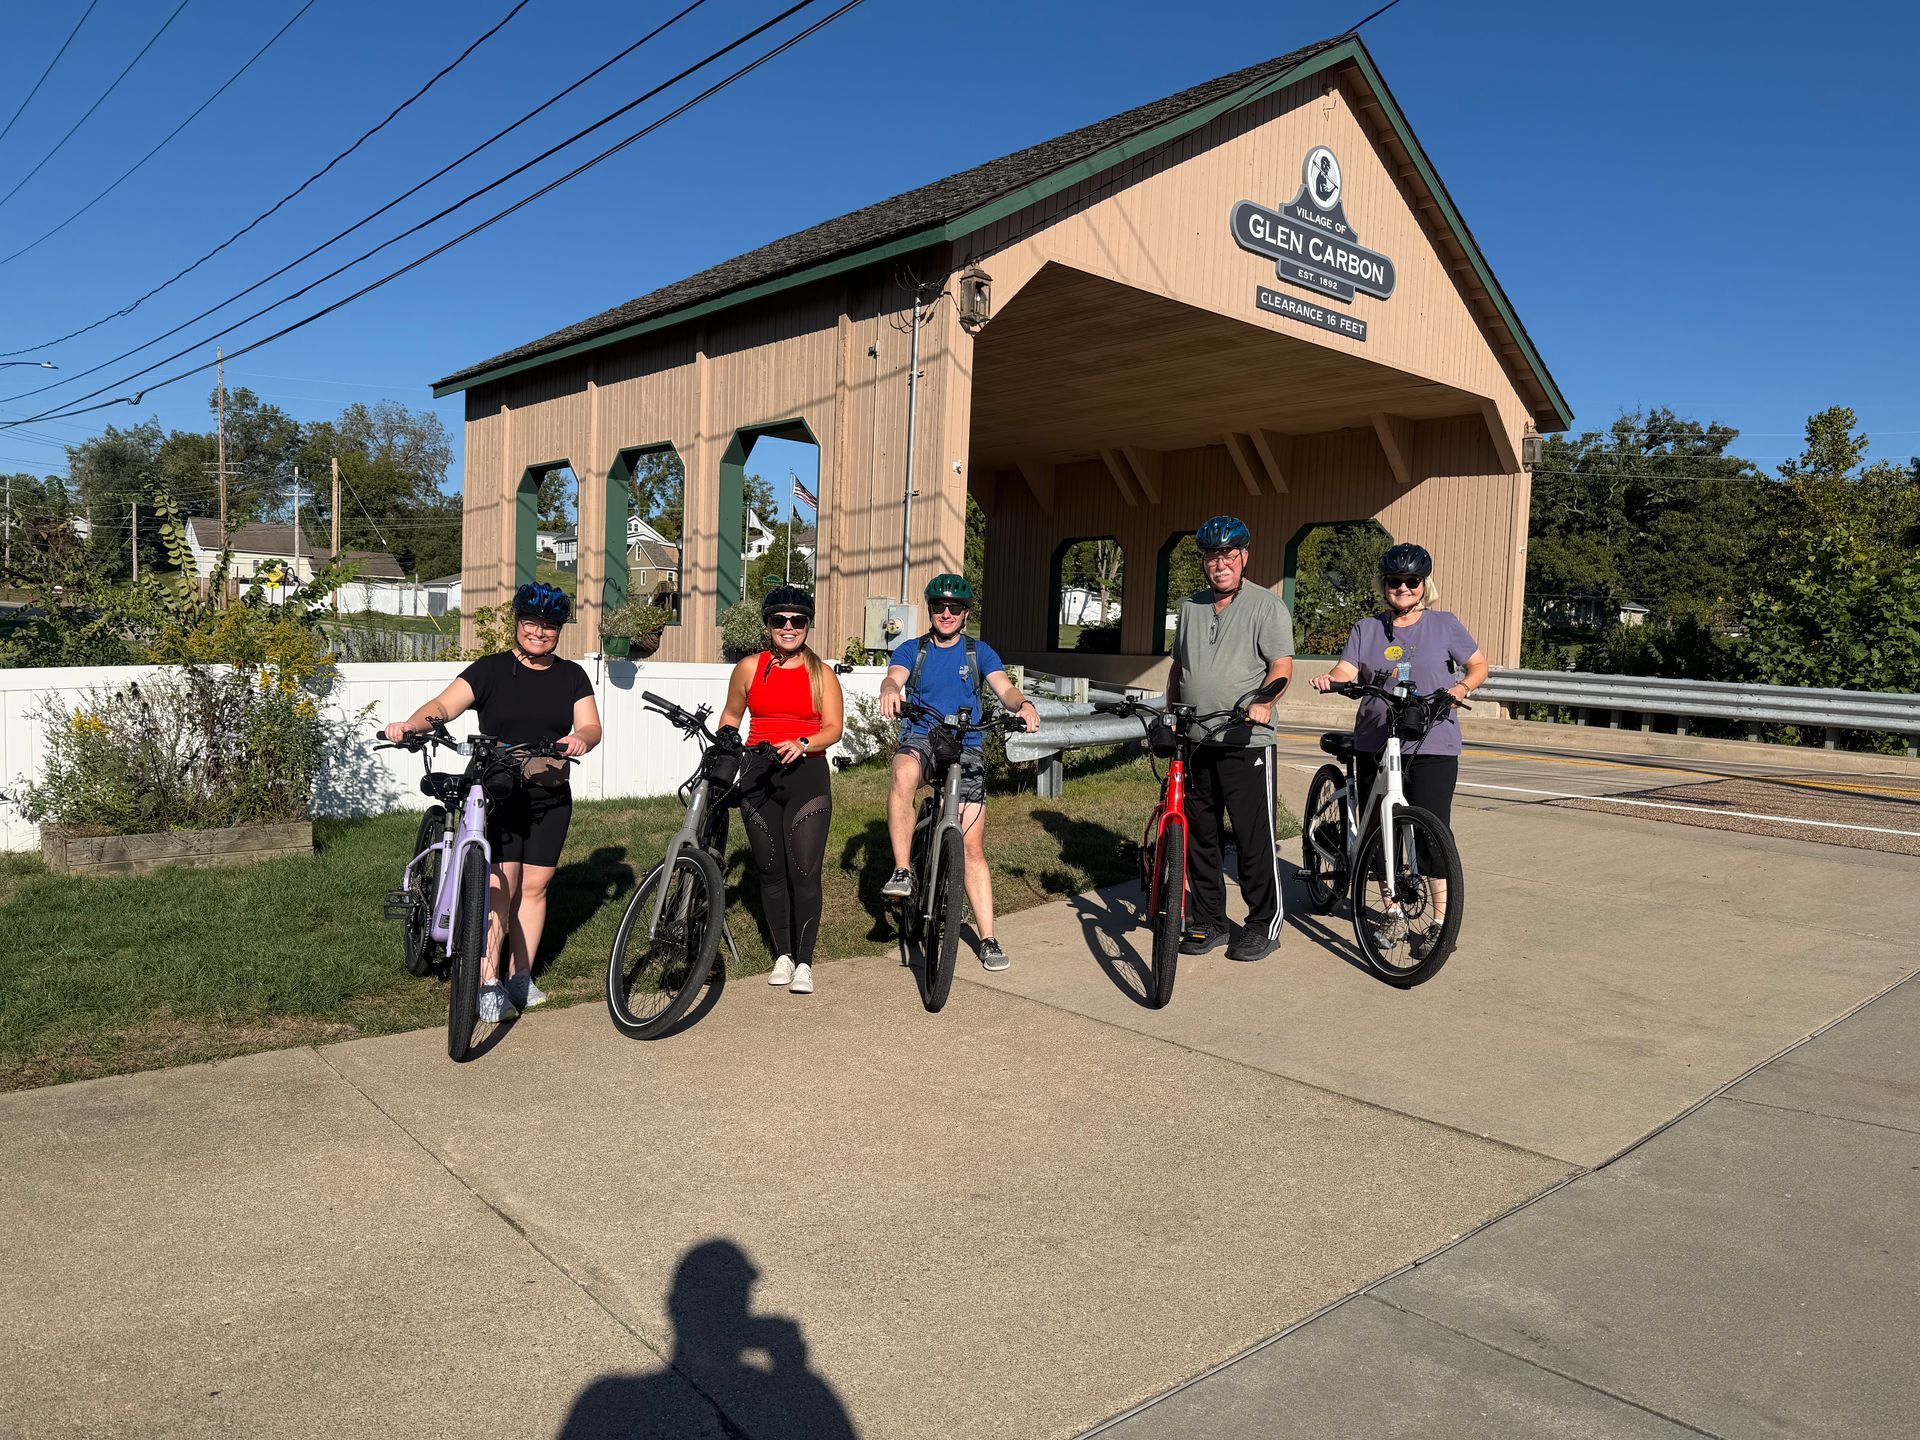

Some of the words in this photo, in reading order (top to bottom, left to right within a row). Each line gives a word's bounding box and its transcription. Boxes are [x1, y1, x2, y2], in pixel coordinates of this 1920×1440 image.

[1296, 205, 1332, 229] VILLAGE
[1335, 222, 1347, 234] OF
[1248, 213, 1303, 255] GLEN
[1308, 237, 1385, 285] CARBON
[1298, 269, 1316, 282] EST.
[1319, 276, 1338, 290] 1892
[1260, 291, 1324, 322] CLEARANCE
[1326, 314, 1337, 326] 16
[1339, 318, 1365, 335] FEET
